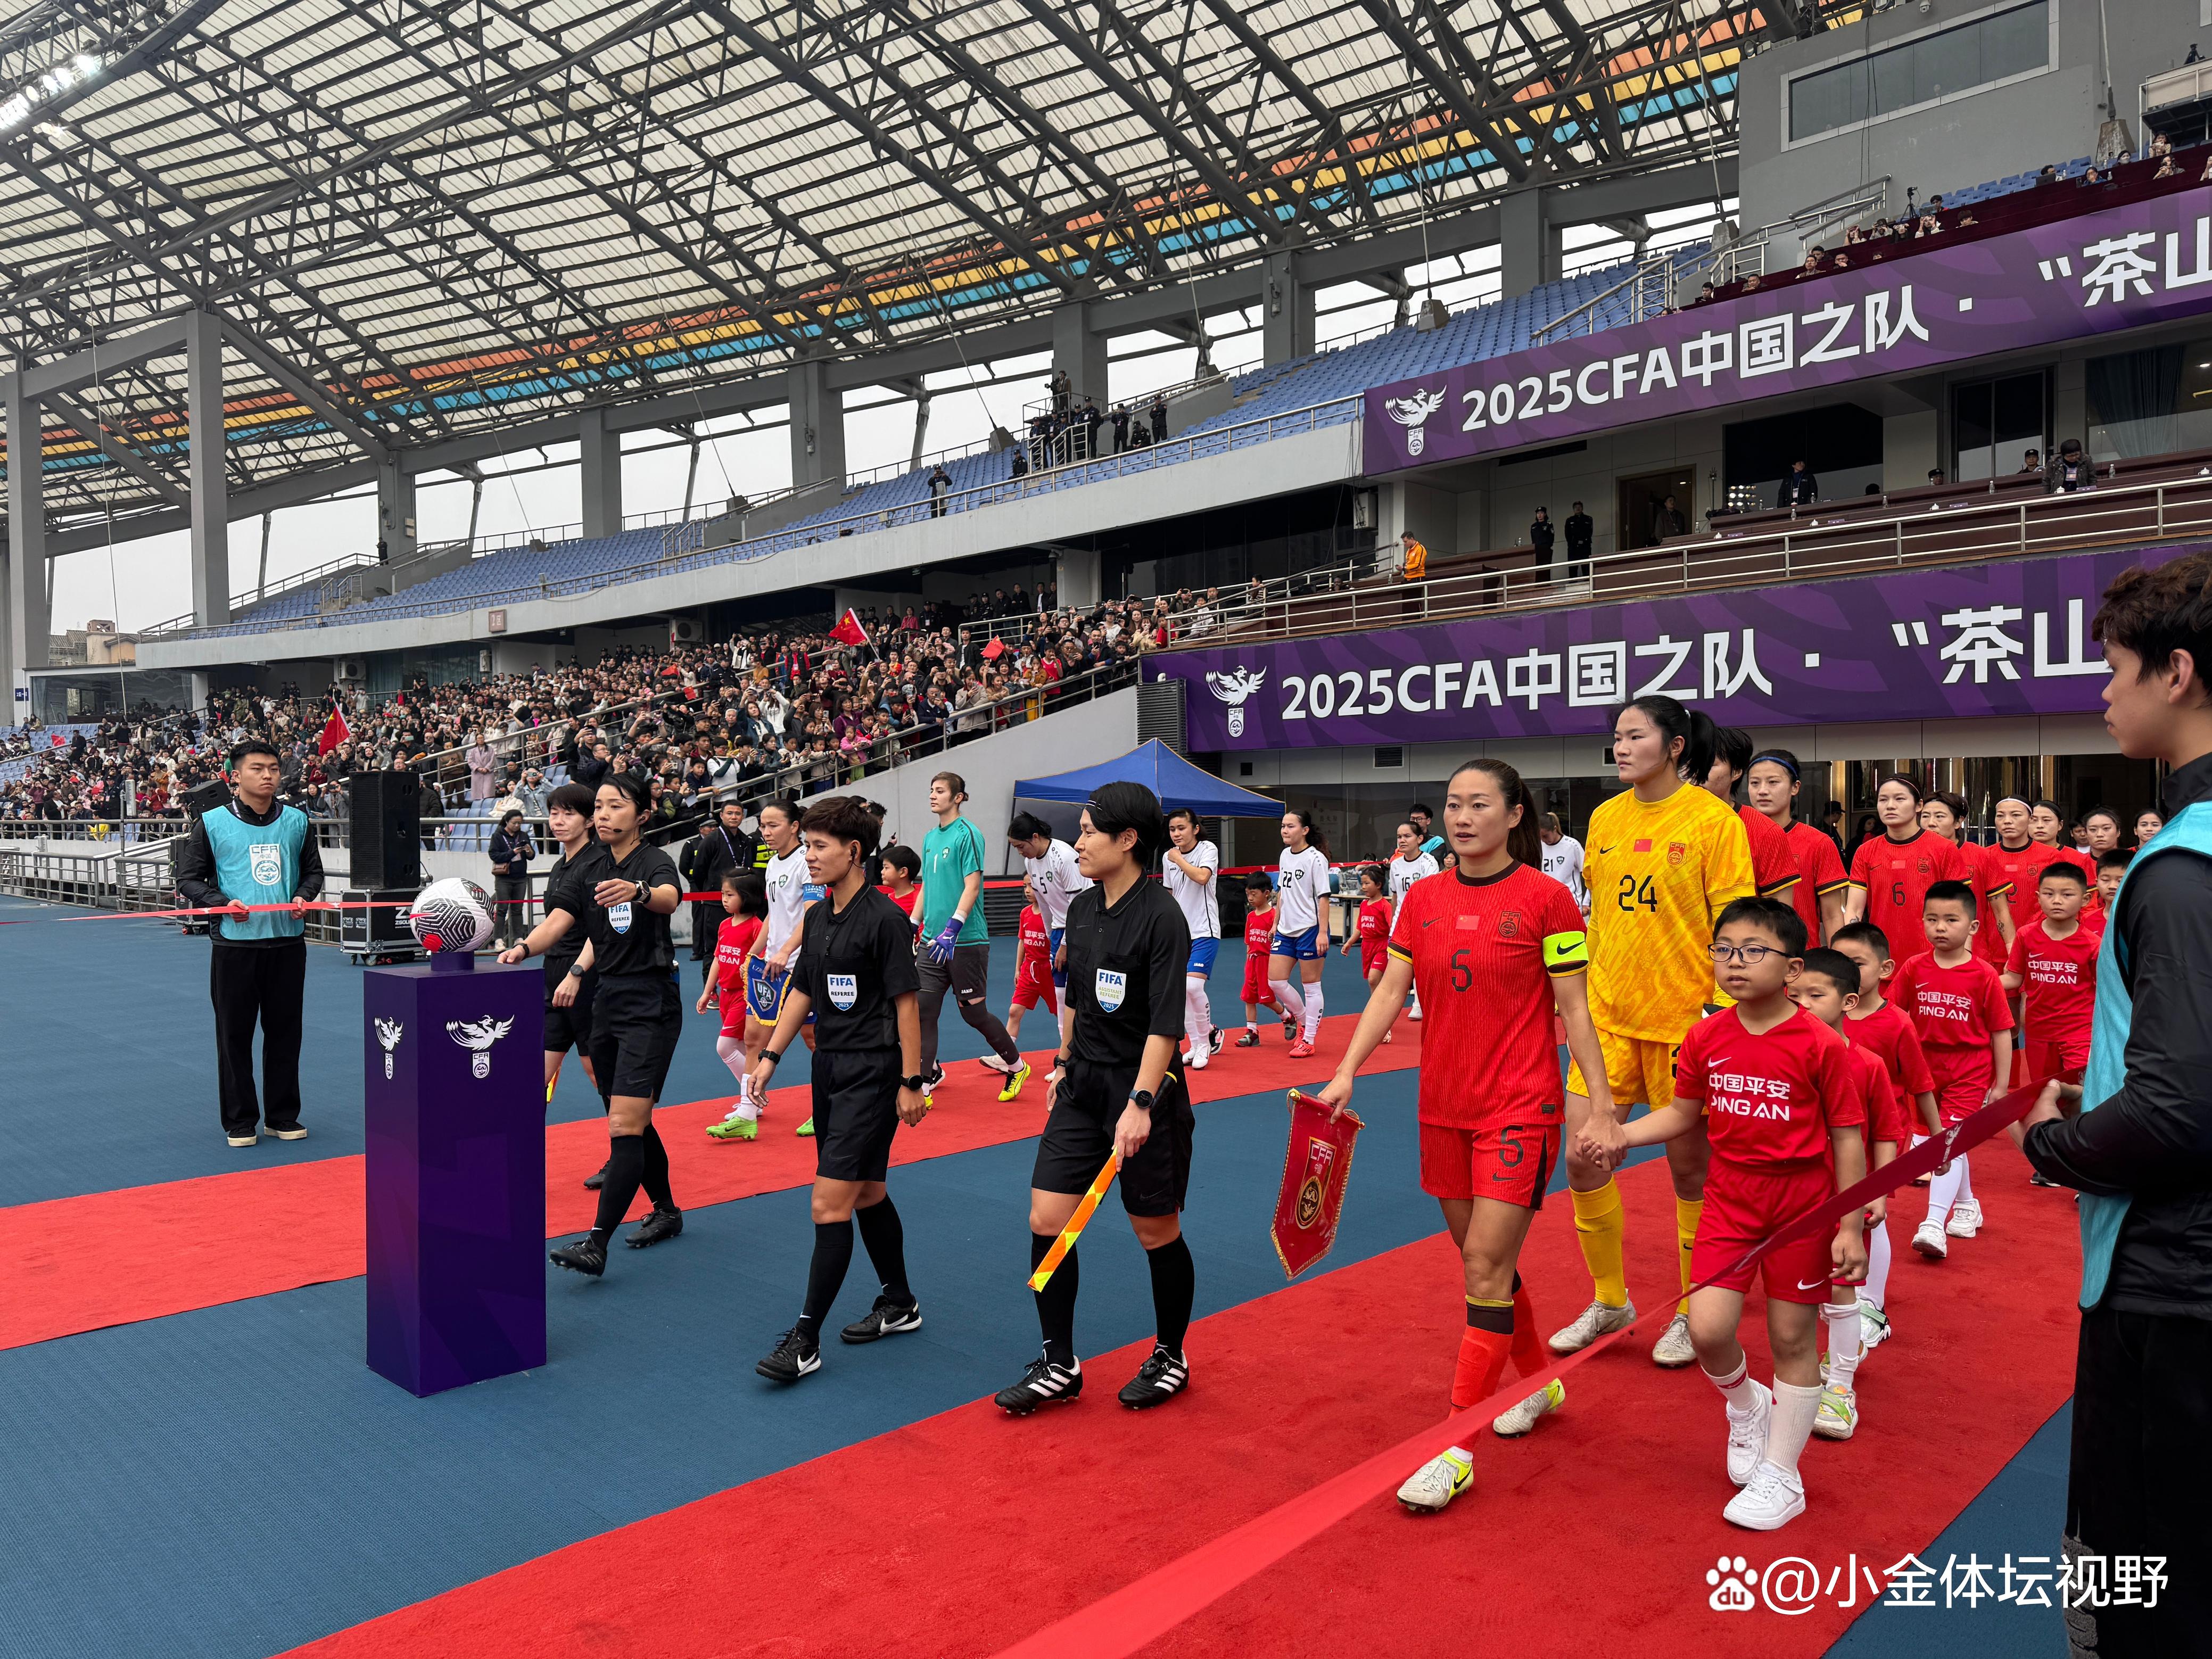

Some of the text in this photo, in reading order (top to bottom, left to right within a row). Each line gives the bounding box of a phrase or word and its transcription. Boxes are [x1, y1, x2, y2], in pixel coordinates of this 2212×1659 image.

[1462, 285, 1929, 432] 2025CFA中国之队
[1282, 628, 1772, 720] 2025CFA中国之队
[251, 845, 278, 854] CFA
[934, 853, 938, 873] 1
[1544, 859, 1553, 872] 21
[1039, 877, 1047, 894] 5
[1283, 871, 1292, 888] 22
[1401, 877, 1410, 892] 16
[1619, 874, 1658, 912] 24
[1893, 881, 1905, 906] 6
[610, 905, 629, 913] FIFA
[1451, 949, 1472, 992] 5
[2028, 960, 2078, 973] 中国平安
[830, 977, 854, 986] FIFA
[1099, 972, 1122, 986] FIFA
[757, 983, 772, 1000] UFA
[1098, 986, 1122, 995] ASSISTANT
[1100, 991, 1120, 1000] REFEREE
[1917, 991, 1971, 1010] 中国平安
[1709, 1072, 1790, 1100] 中国平安
[1310, 1143, 1333, 1166] CFA
[1499, 1125, 1524, 1168] 5
